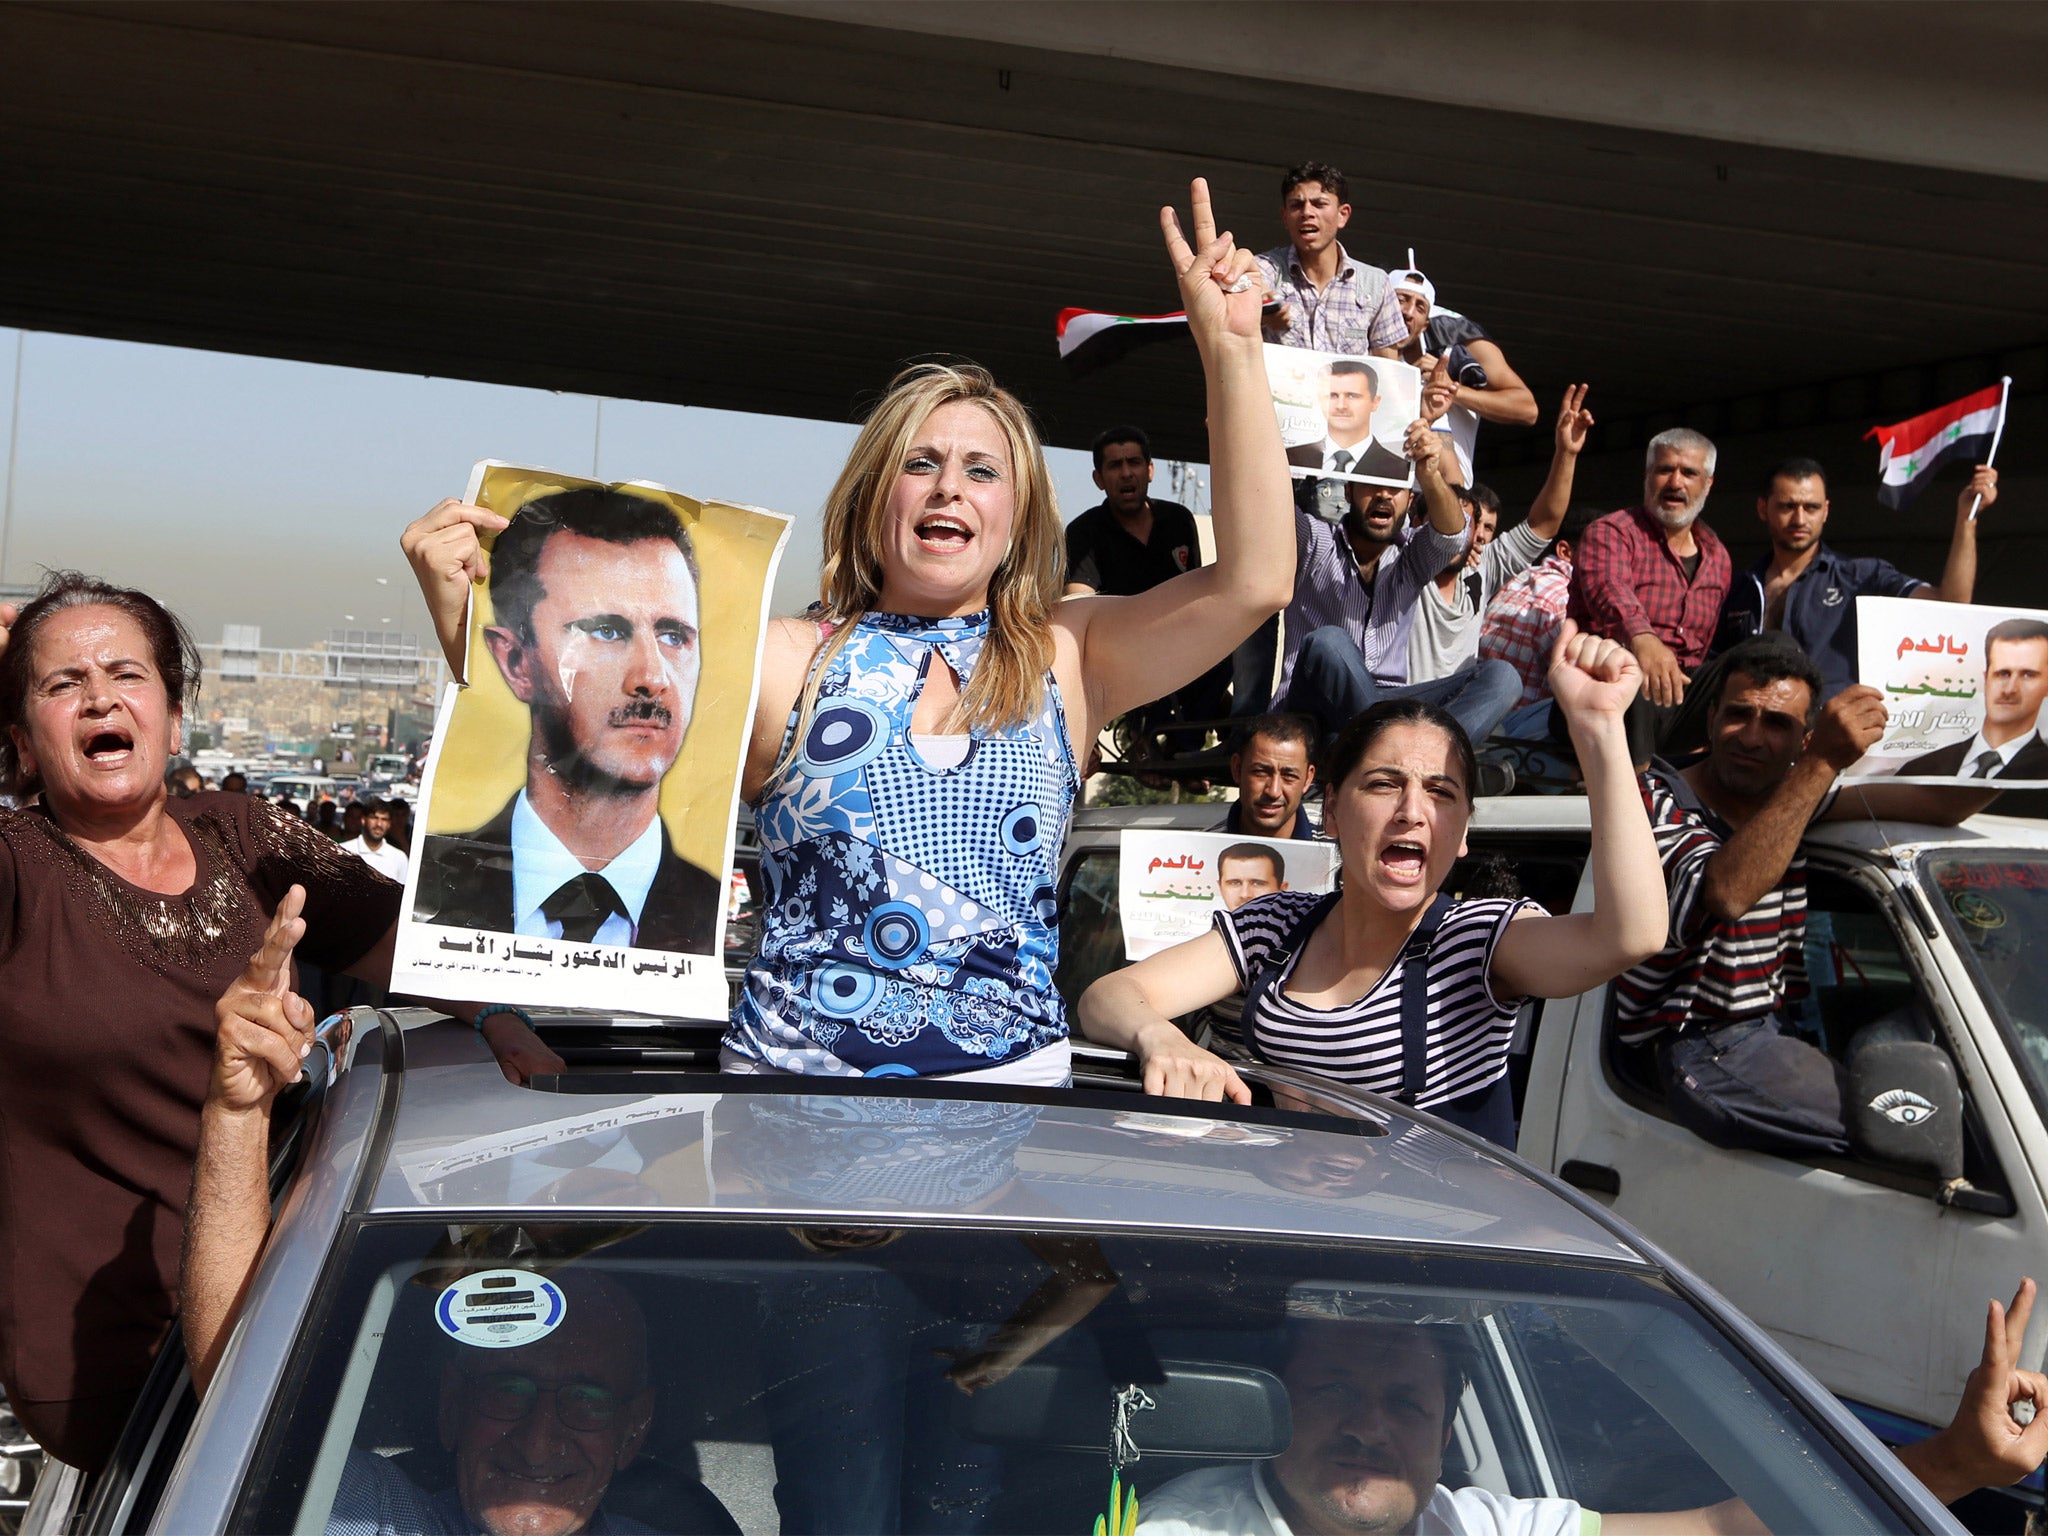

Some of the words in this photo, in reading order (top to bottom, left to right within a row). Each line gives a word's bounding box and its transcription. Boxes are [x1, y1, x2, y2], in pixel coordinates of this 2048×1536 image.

[1897, 634, 1968, 663] بالدم
[1885, 676, 1977, 701] ننتخب
[1922, 709, 1976, 735] بشار
[1148, 854, 1205, 875] بالدم
[1139, 884, 1215, 903] ننتخب
[439, 931, 494, 954] الأسد
[502, 940, 553, 967] بشار
[561, 949, 626, 969] الدكتور
[633, 955, 692, 978] الرئيس
